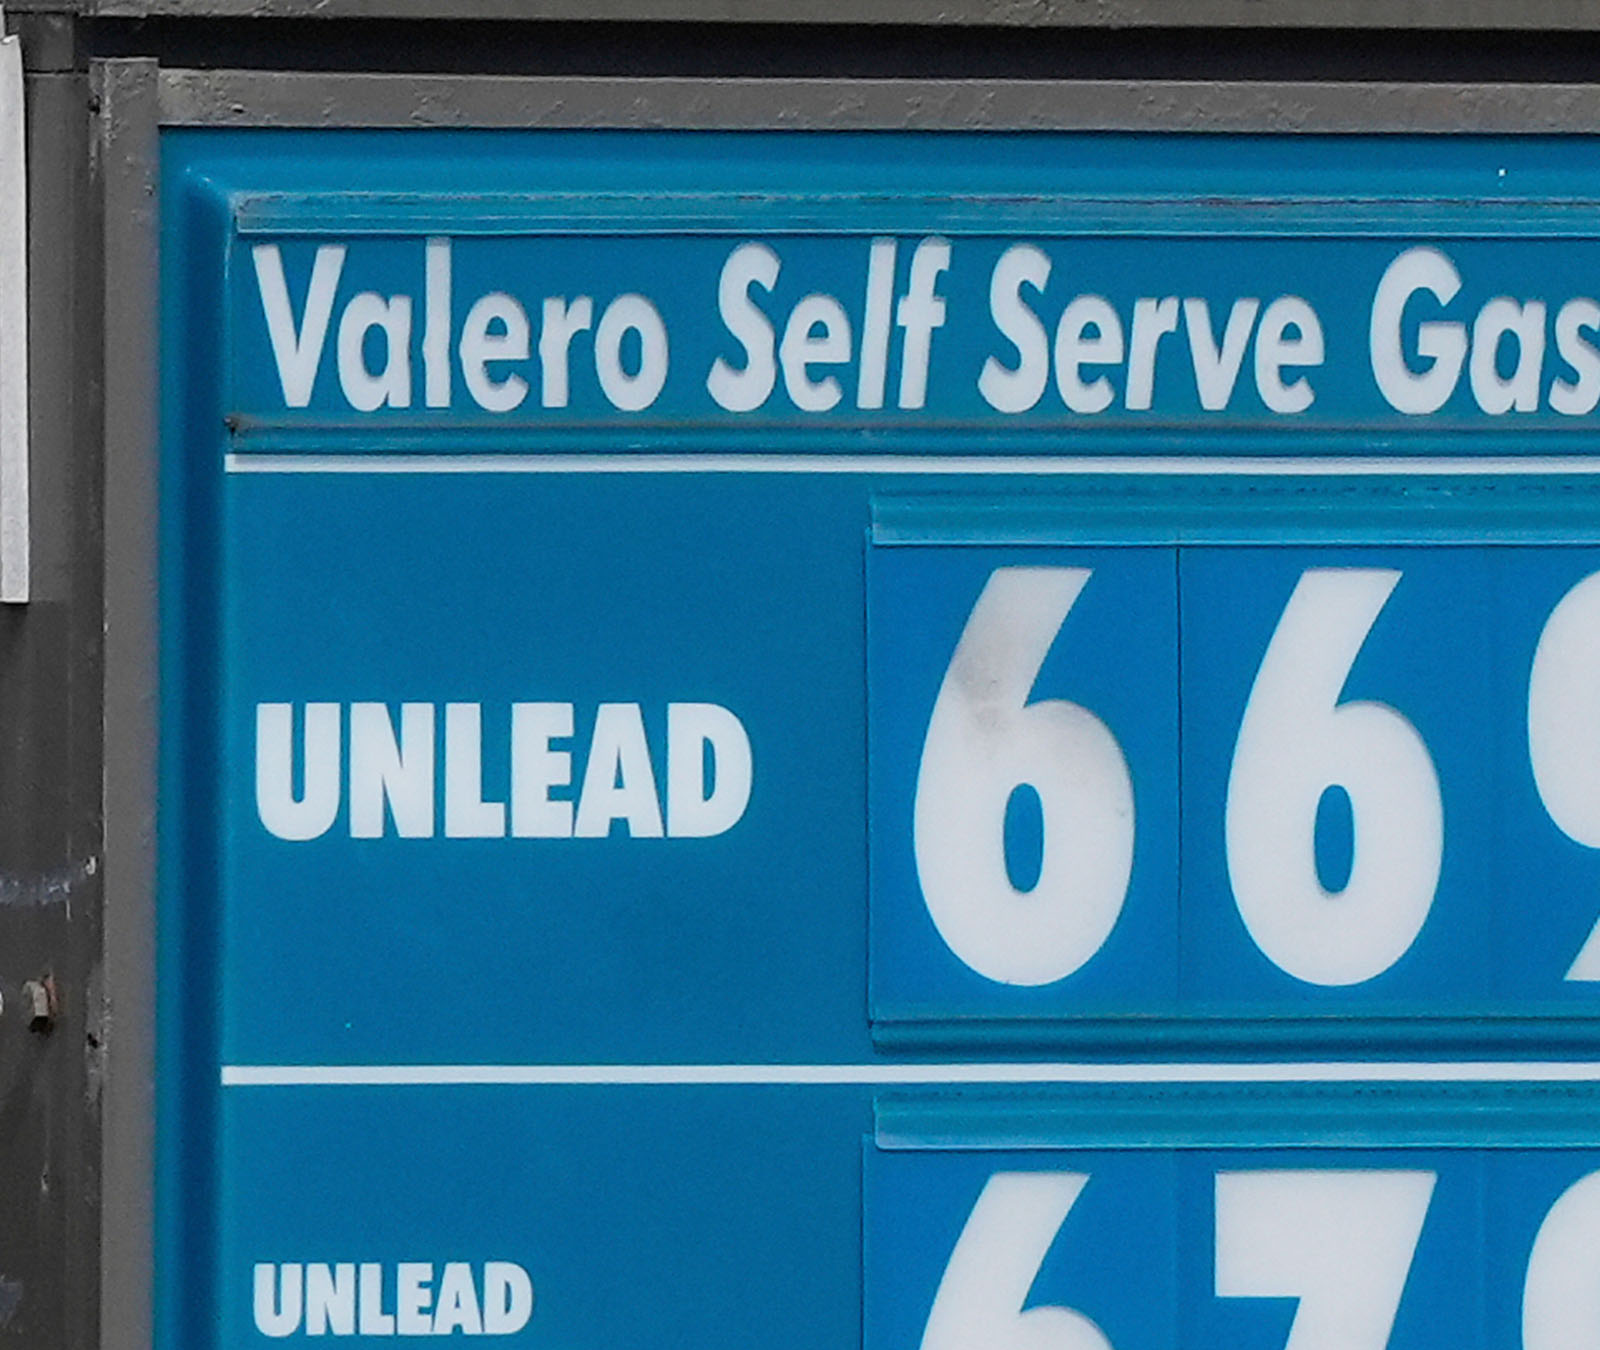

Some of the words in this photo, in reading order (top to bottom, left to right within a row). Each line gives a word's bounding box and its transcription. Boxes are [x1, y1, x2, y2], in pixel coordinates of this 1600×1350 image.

[252, 240, 669, 413] Valero
[707, 238, 950, 413] Self
[979, 247, 1324, 414] Serve
[256, 702, 753, 842] UNLEAD
[253, 1262, 533, 1338] UNLEAD
